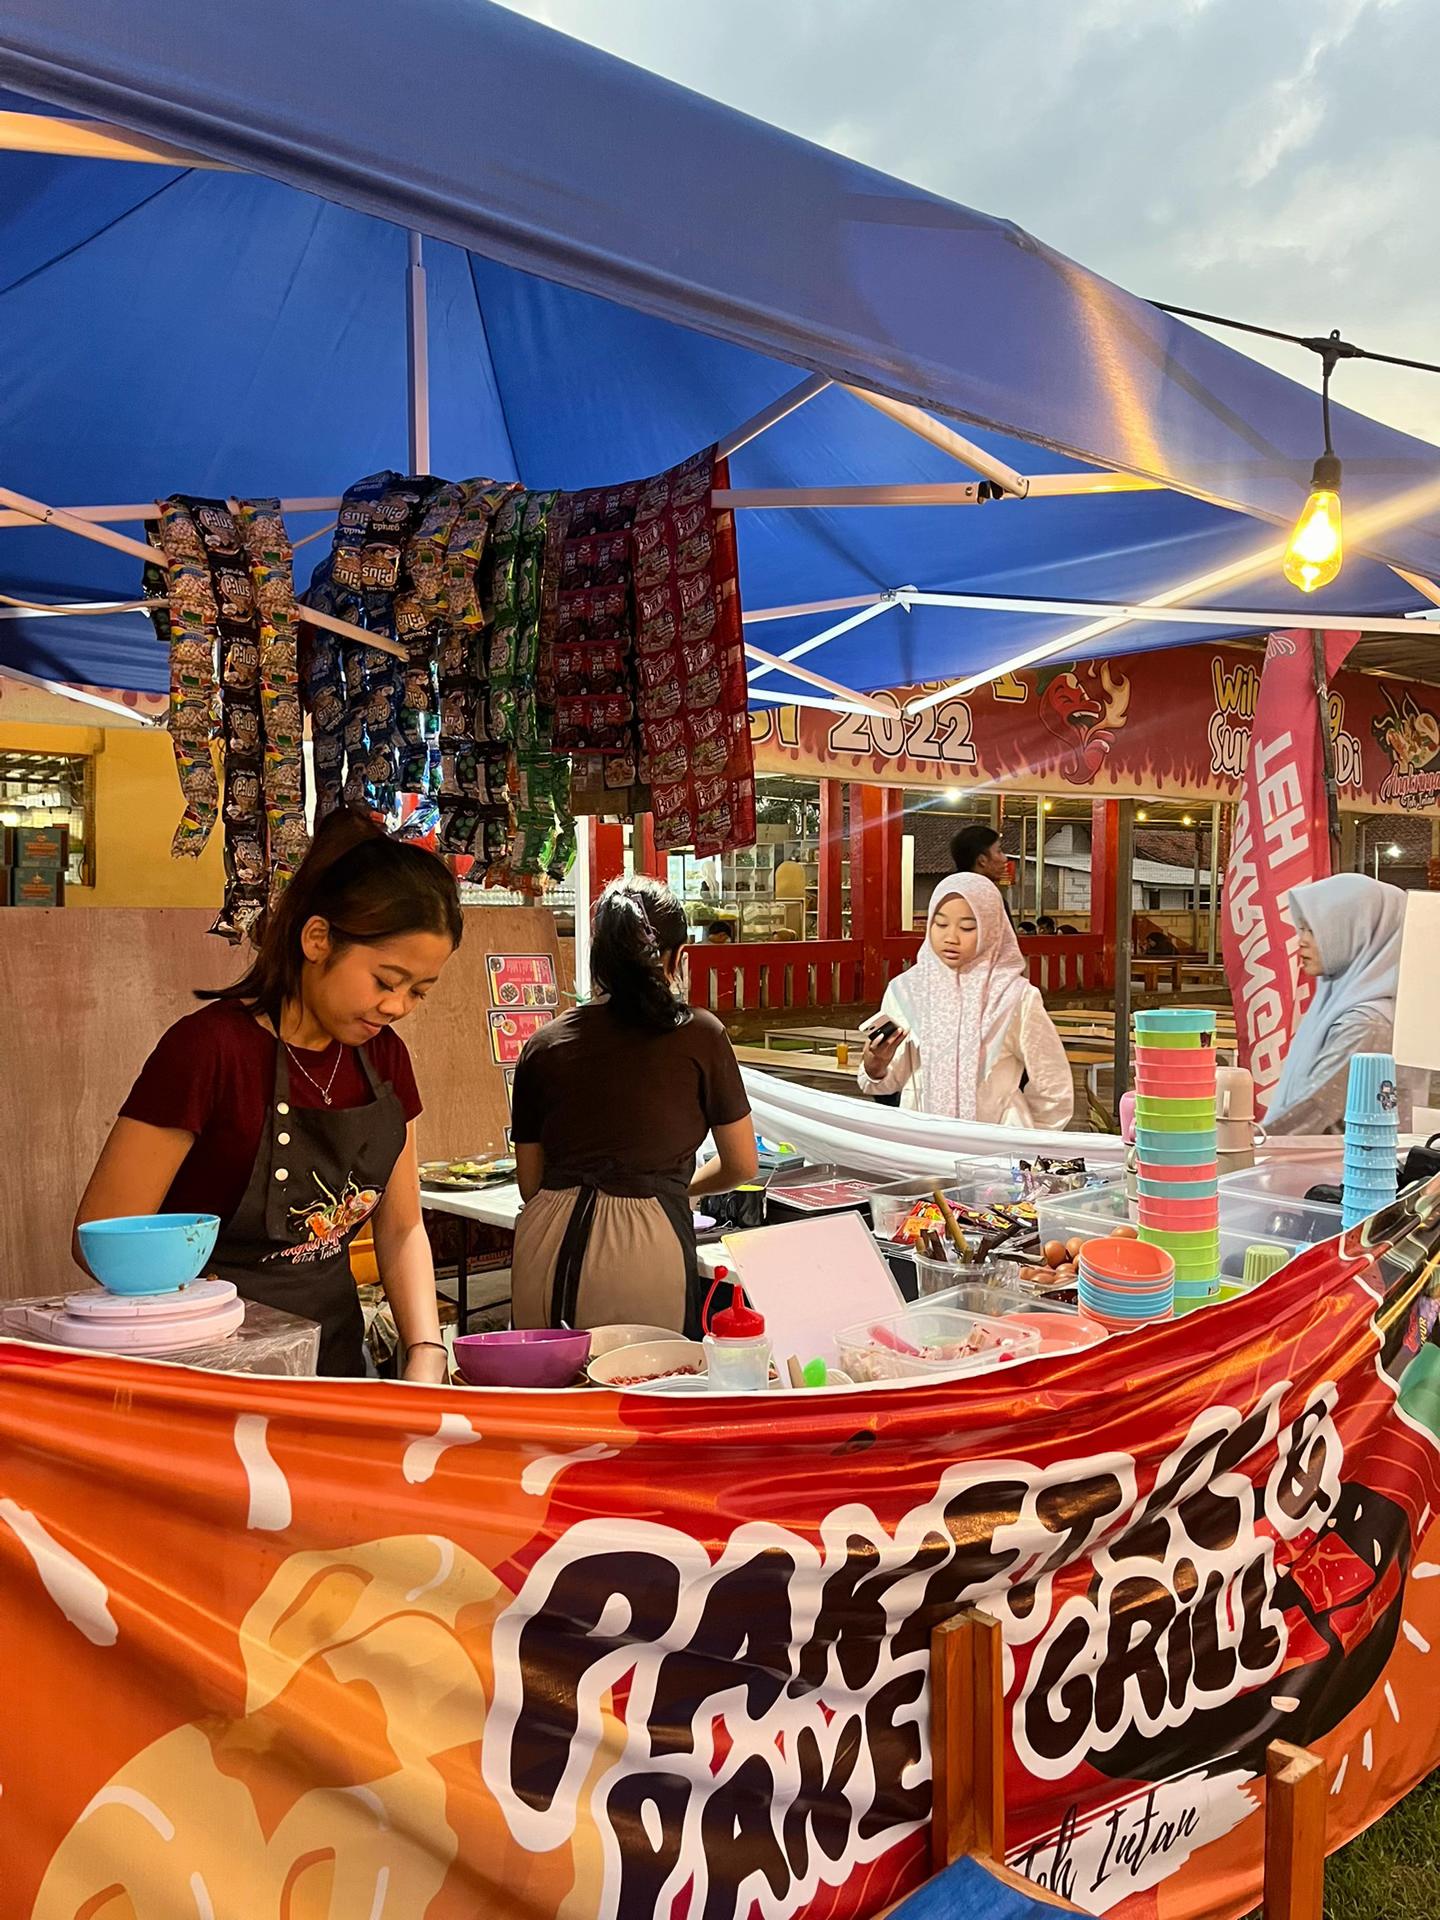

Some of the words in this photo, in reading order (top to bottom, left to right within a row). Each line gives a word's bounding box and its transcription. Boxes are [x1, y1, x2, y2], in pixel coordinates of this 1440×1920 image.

[205, 509, 234, 529] Pilus
[375, 503, 408, 520] Pilus
[225, 578, 251, 597] Pilus
[362, 566, 393, 583] Pilus
[233, 645, 257, 665] Pilus
[831, 690, 976, 763] 2022
[1336, 733, 1362, 786] Di
[510, 1473, 1122, 1812] PAKET
[607, 1669, 933, 1920] PAKE
[1090, 1790, 1200, 1893] Intan
